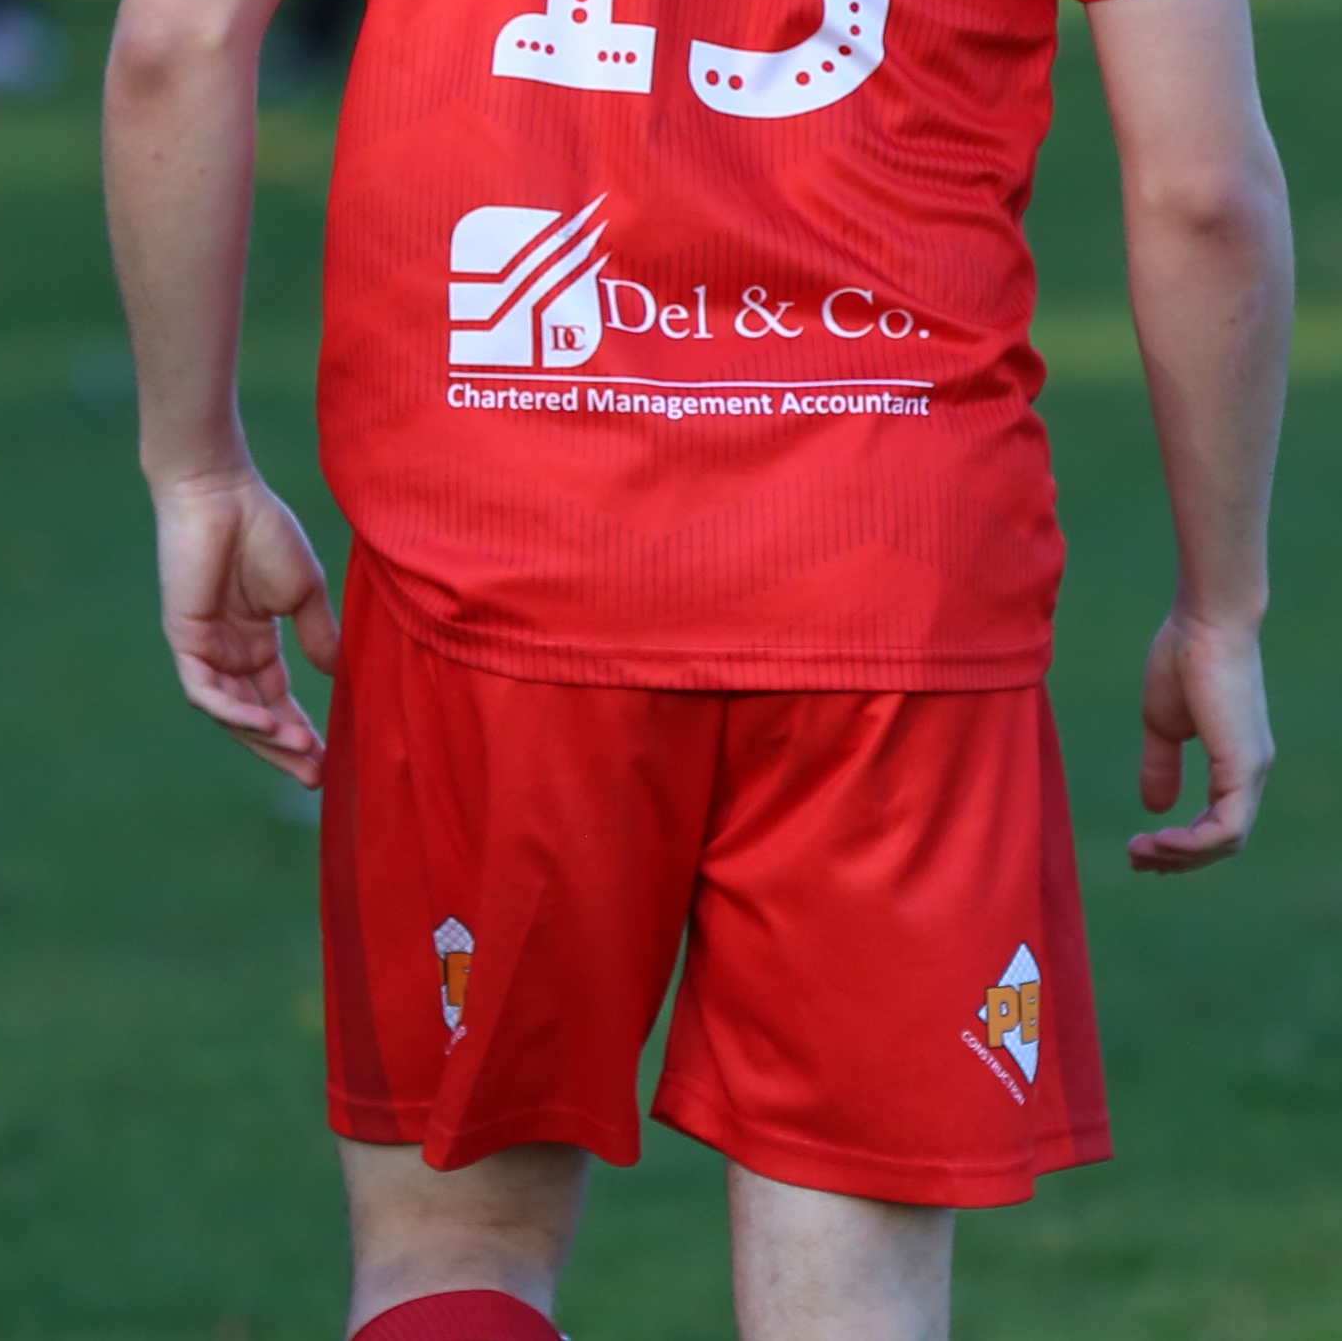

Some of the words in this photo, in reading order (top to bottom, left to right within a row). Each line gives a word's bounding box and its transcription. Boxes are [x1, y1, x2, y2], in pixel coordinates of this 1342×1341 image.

[599, 275, 715, 340] Del
[733, 285, 804, 340] &
[821, 286, 931, 340] Co.
[446, 381, 580, 412] Chartered
[585, 387, 774, 421] Management
[779, 390, 931, 417] Accountant
